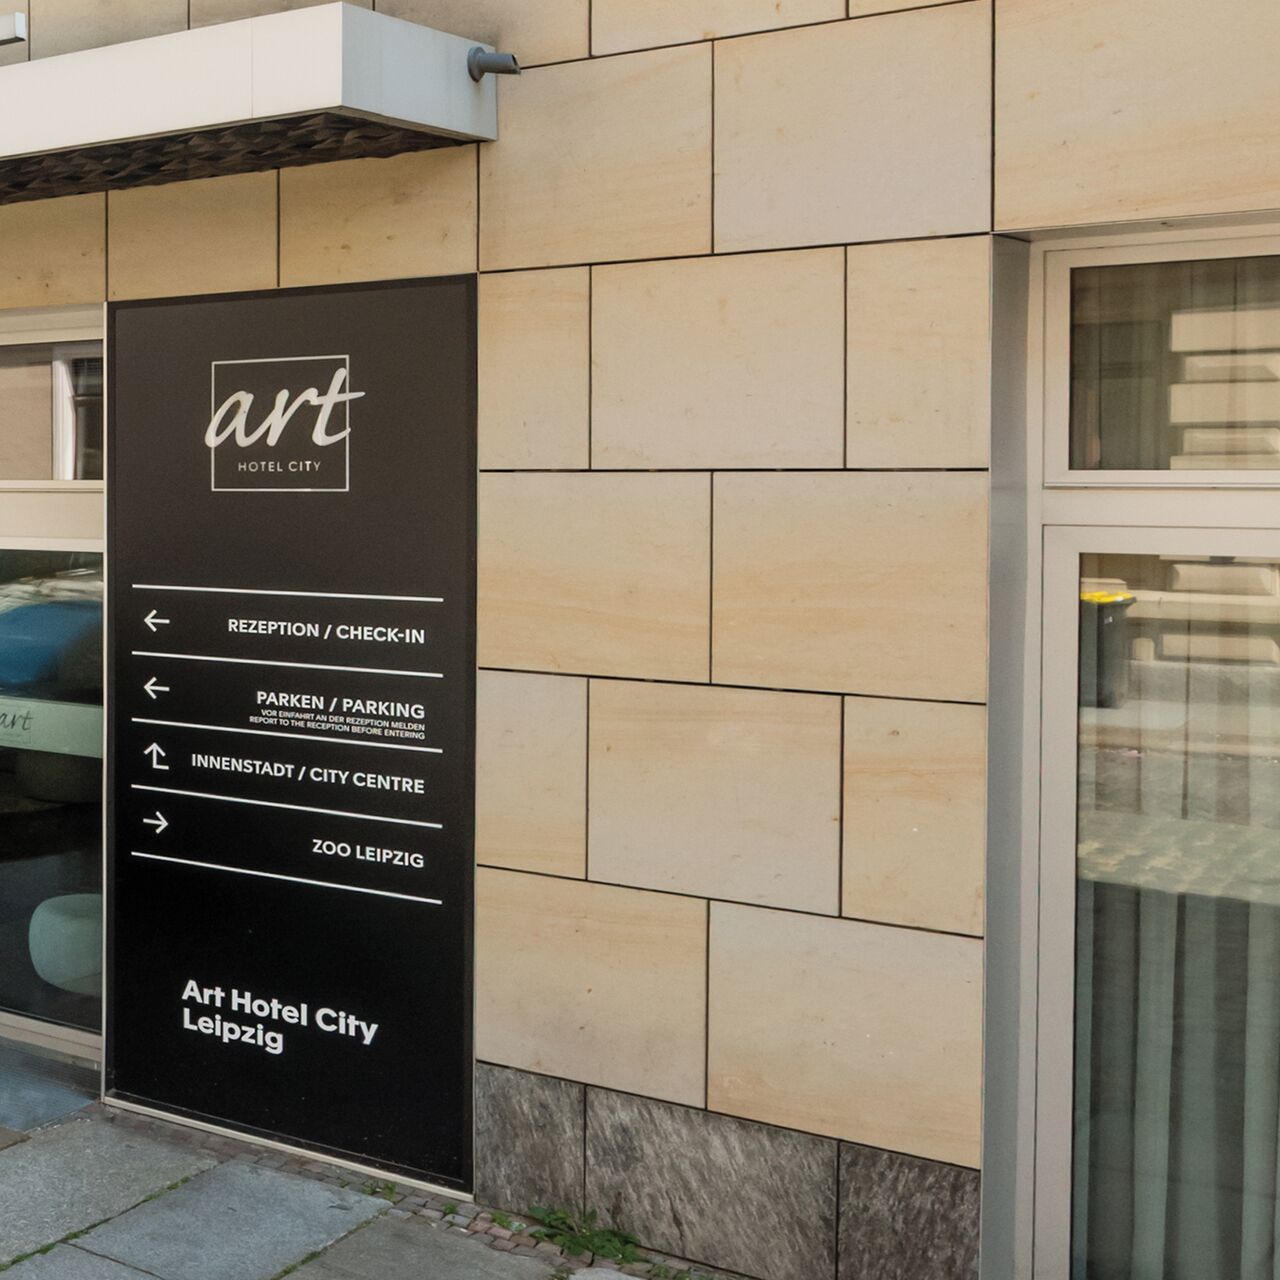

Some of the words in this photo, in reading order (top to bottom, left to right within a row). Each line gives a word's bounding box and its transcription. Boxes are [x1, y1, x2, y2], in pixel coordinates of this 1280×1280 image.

[204, 367, 366, 449] art
[237, 460, 285, 473] HOTEL
[288, 460, 322, 473] CITY
[228, 618, 320, 639] REZEPTION
[323, 624, 333, 641] /
[336, 625, 425, 645] CHECK-IN
[256, 690, 325, 711] PARKEN
[329, 697, 338, 713] /
[342, 698, 426, 719] PARKING
[249, 715, 278, 726] REPORT
[279, 718, 290, 727] TO
[291, 719, 306, 729] THE
[306, 721, 350, 733] RECEPTION
[351, 725, 384, 737] BEFORE
[384, 728, 426, 740] ENTERING
[261, 709, 278, 718] VOR
[279, 710, 315, 721] EINFAHRT
[316, 713, 328, 722] AN
[328, 715, 345, 724] DER
[346, 716, 391, 728] REZEPTION
[391, 720, 426, 732] MELDEN
[191, 752, 295, 780] INNENSTADT
[297, 765, 307, 781] /
[309, 766, 350, 786] CITY
[352, 771, 425, 795] CENTRE
[312, 837, 352, 859] ZOO
[355, 844, 425, 869] LEIPZIG
[181, 979, 225, 1008] Art
[231, 989, 309, 1027] Hotel
[315, 1006, 379, 1046] City
[183, 1007, 284, 1055] Leipzig
